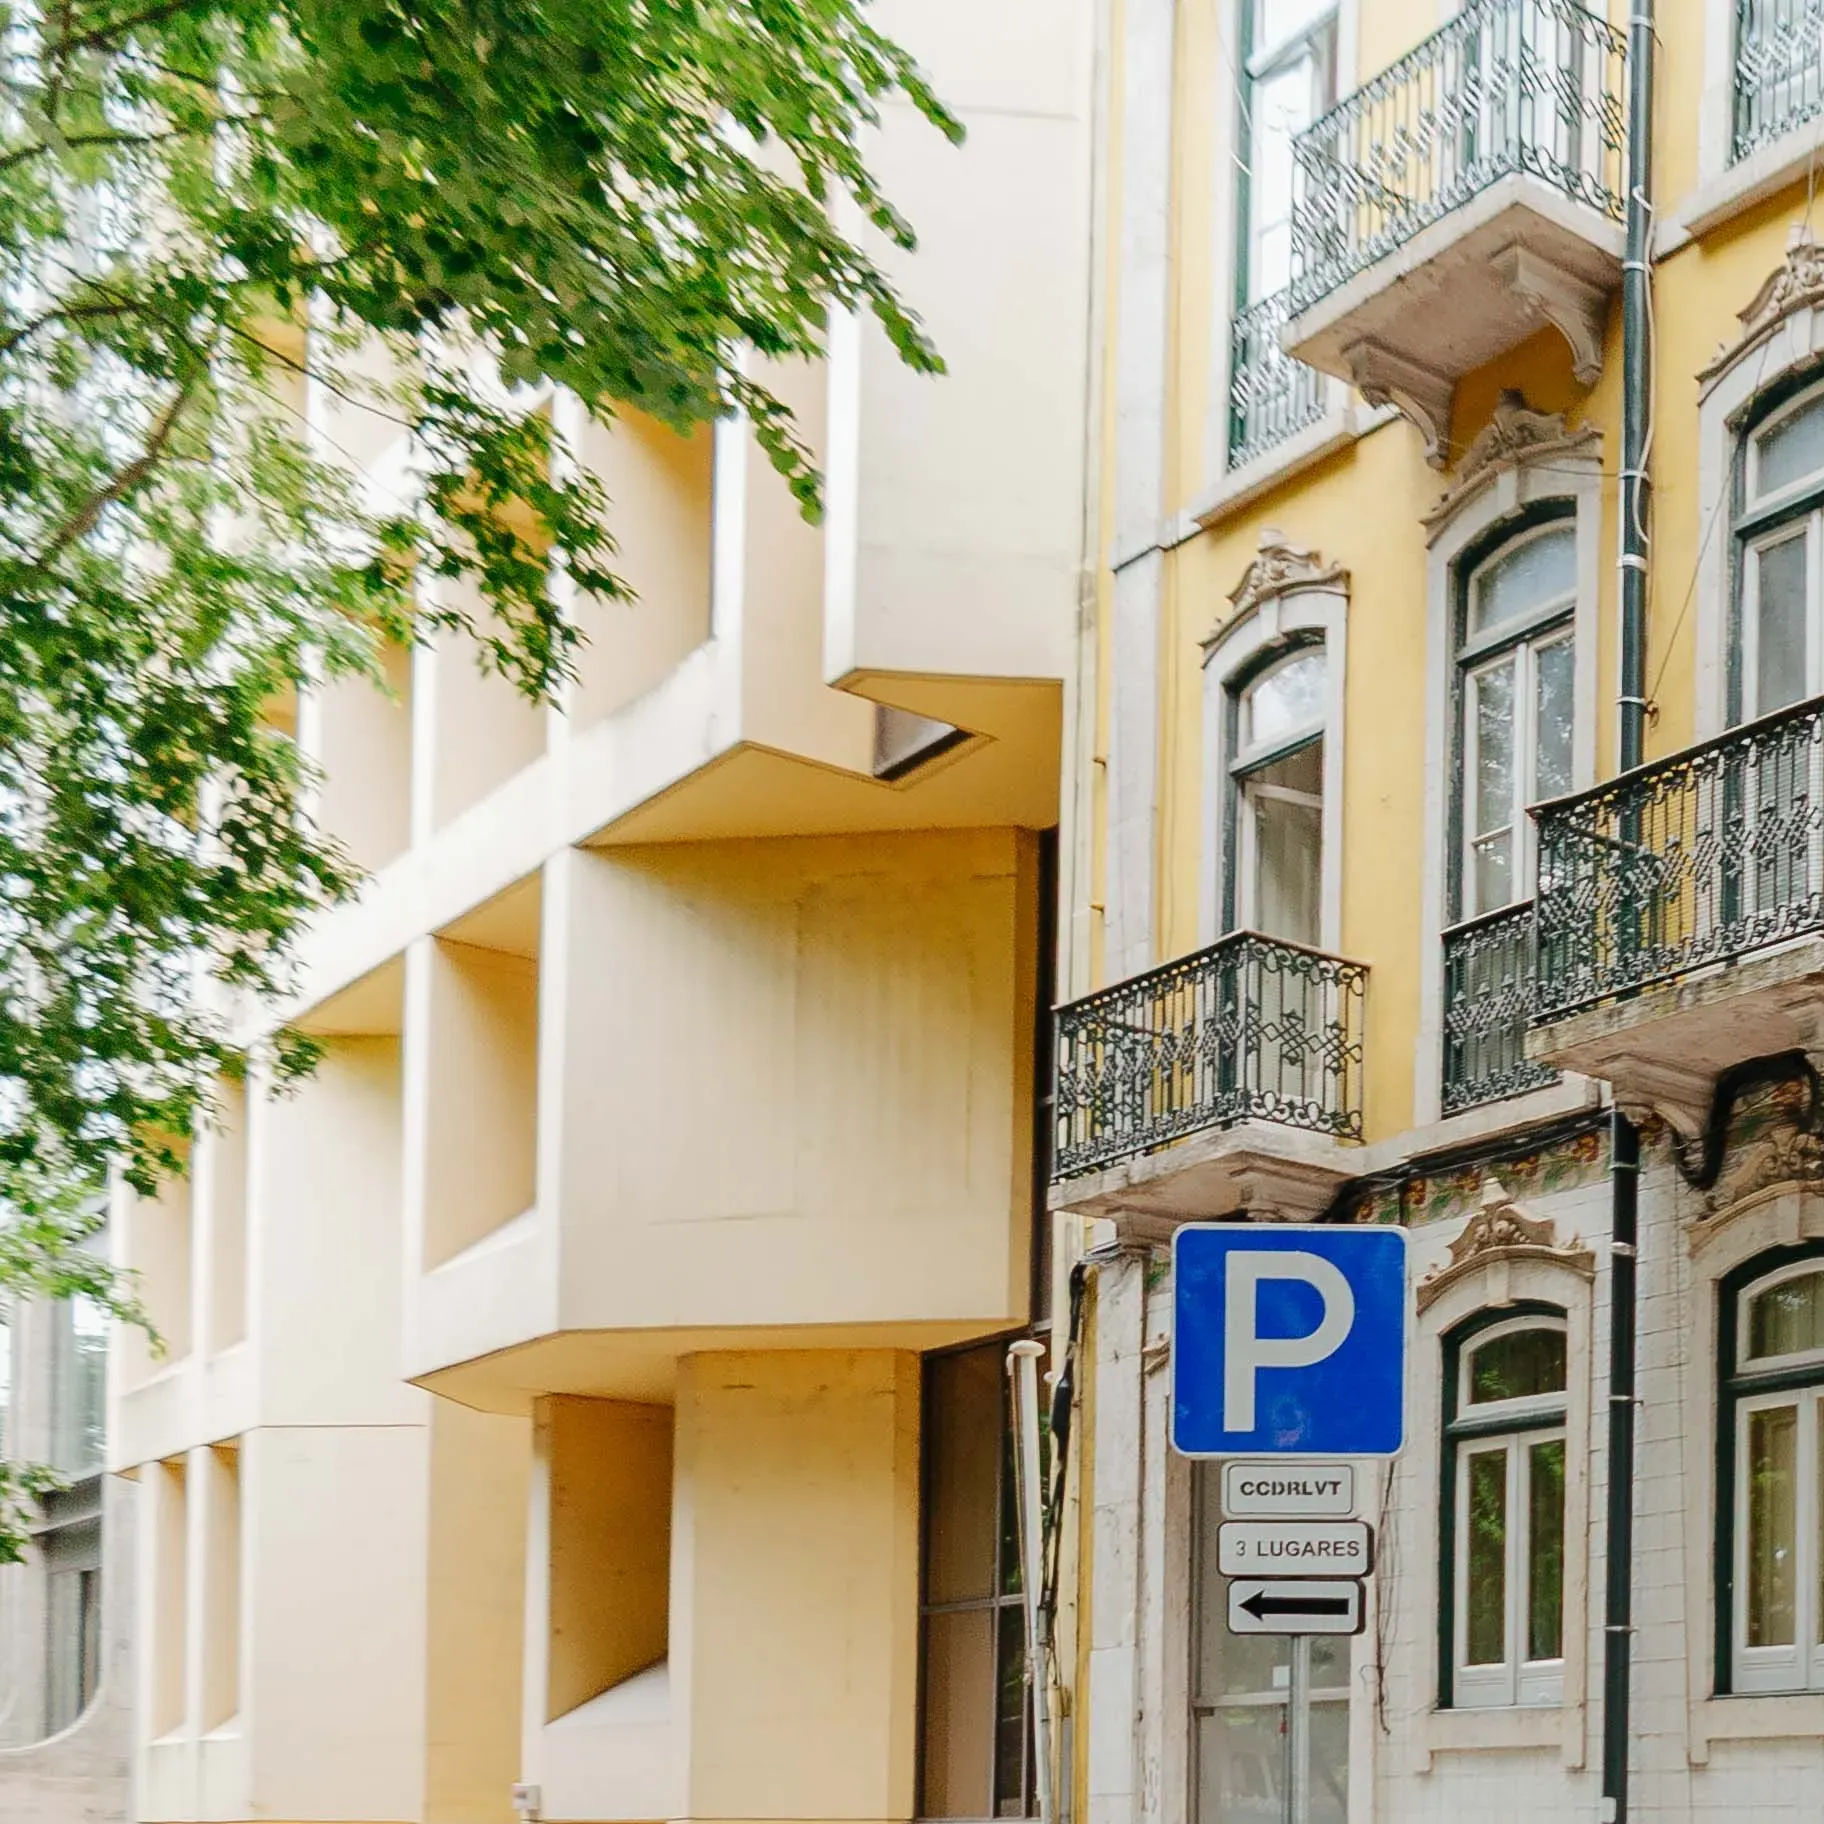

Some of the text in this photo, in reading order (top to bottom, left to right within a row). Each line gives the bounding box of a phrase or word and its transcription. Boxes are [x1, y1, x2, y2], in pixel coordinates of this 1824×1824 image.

[1223, 1249, 1356, 1433] P
[1235, 1540, 1360, 1557] 3 LUGARES
